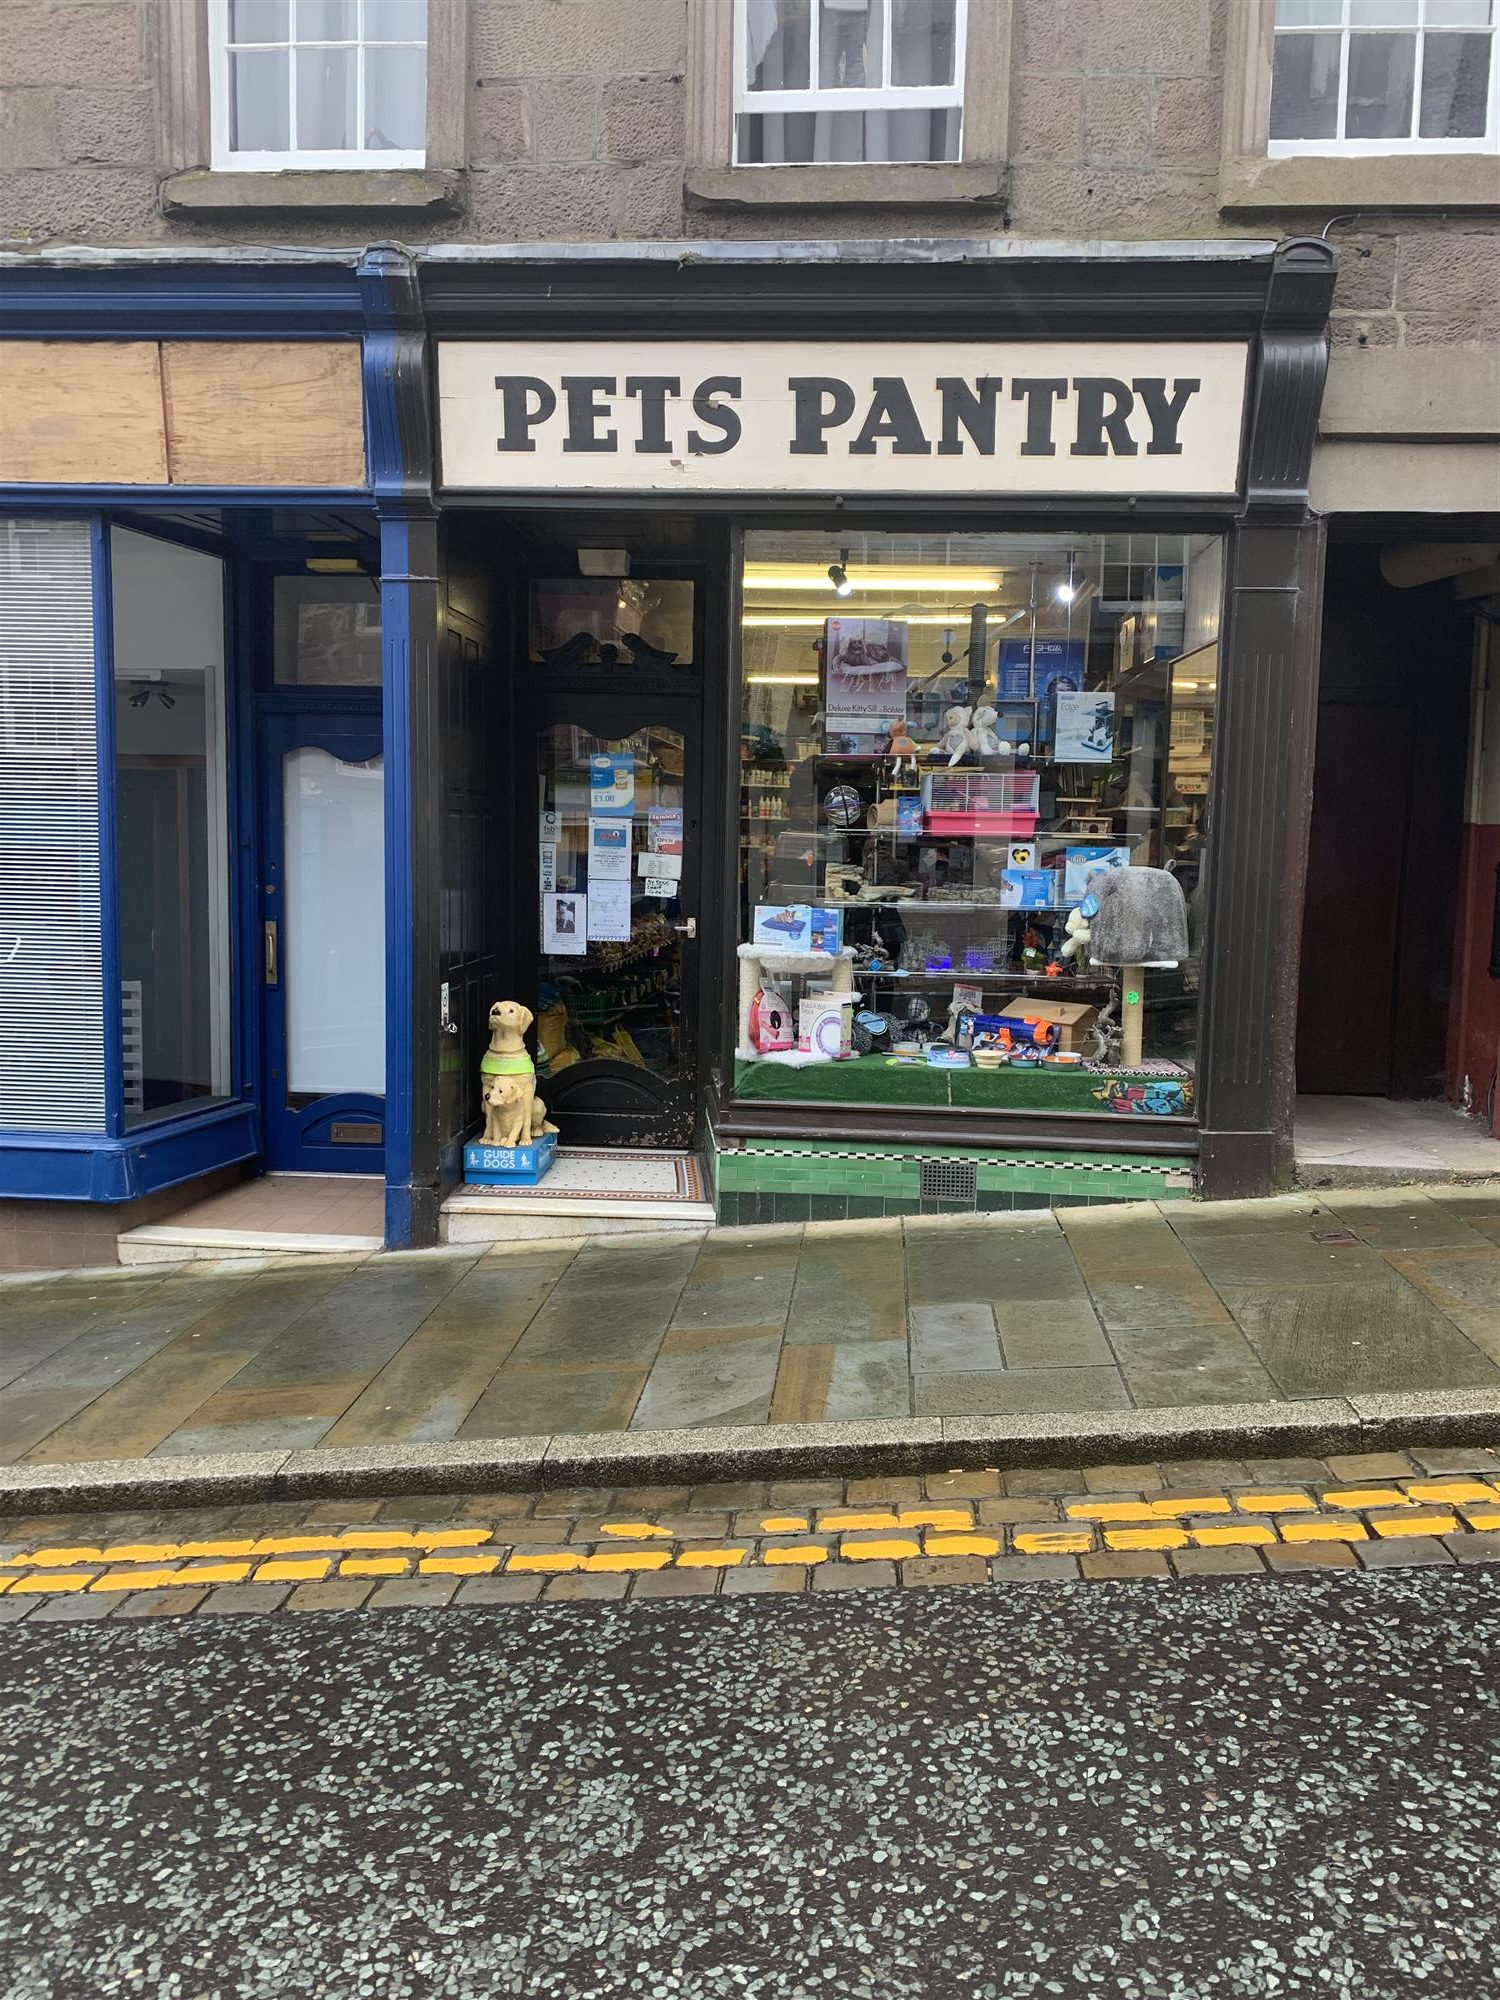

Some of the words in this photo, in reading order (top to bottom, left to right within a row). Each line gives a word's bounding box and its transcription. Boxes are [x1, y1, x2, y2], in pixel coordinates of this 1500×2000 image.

[494, 375, 743, 456] PETS
[788, 375, 1201, 457] PANTRY
[827, 703, 851, 712] Deluxe
[851, 704, 867, 714] Kitty
[882, 705, 904, 713] Bolster
[1060, 702, 1080, 712] Edge
[593, 794, 615, 803] £1.00
[543, 825, 556, 833] fsb
[483, 1149, 516, 1160] GUIDE
[483, 1159, 516, 1169] DOGS
